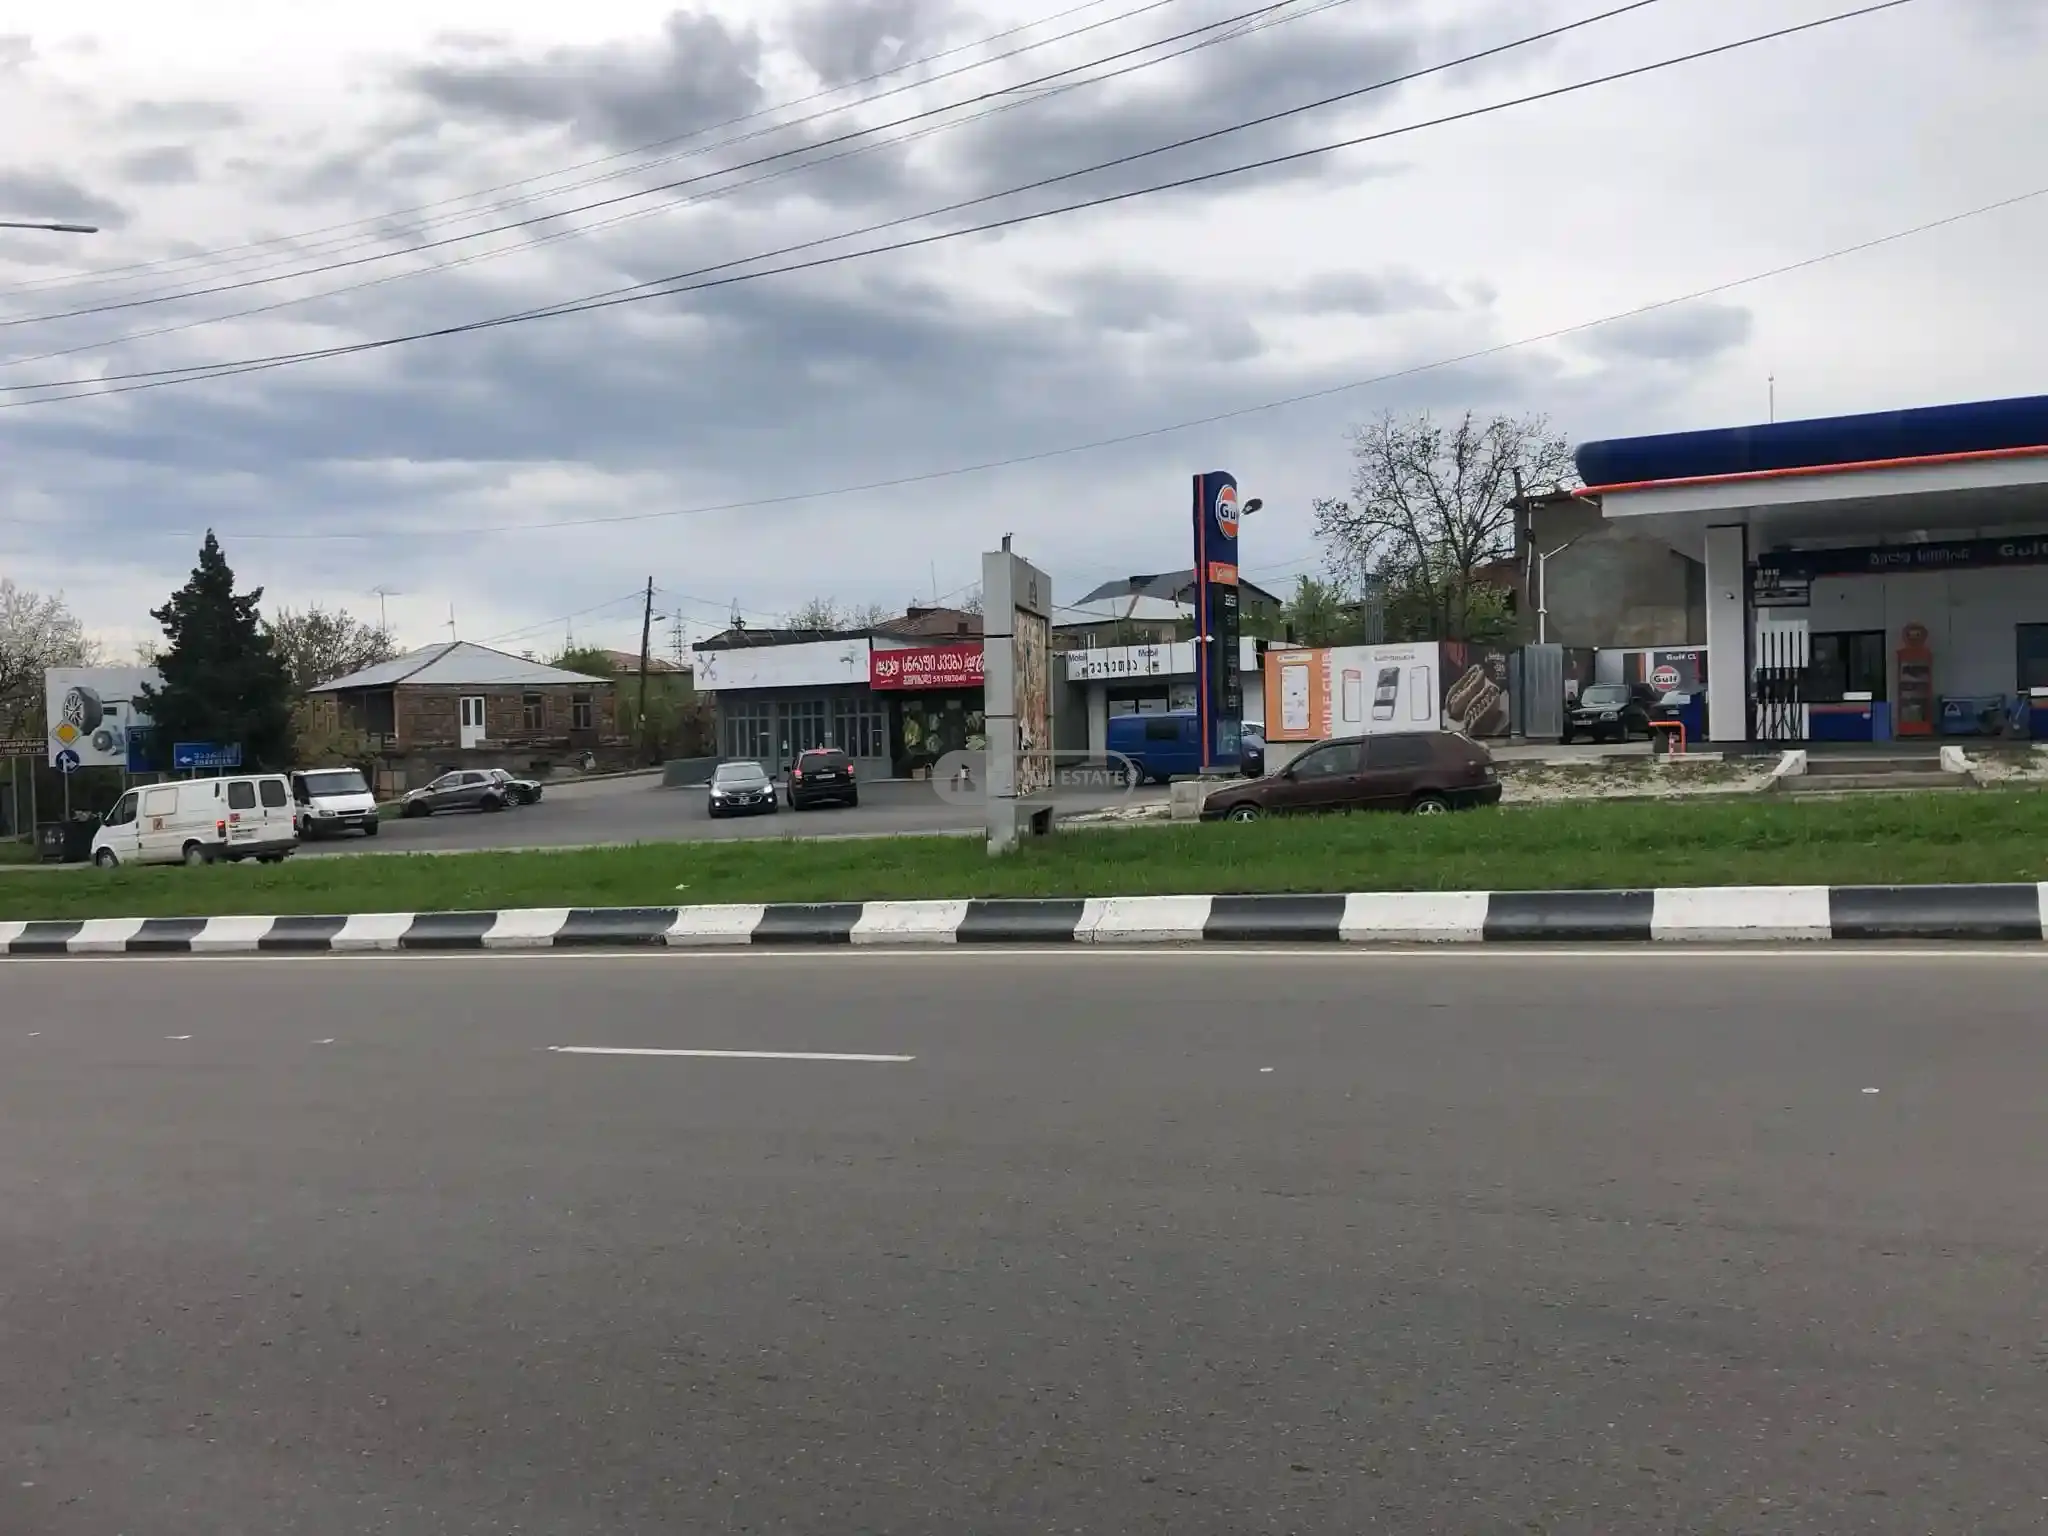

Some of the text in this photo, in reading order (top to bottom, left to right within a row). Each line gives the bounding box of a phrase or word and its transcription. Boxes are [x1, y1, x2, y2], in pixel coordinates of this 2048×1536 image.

[1138, 647, 1158, 657] Mobil
[937, 652, 963, 671] კვება
[1653, 674, 1678, 684] Gulf
